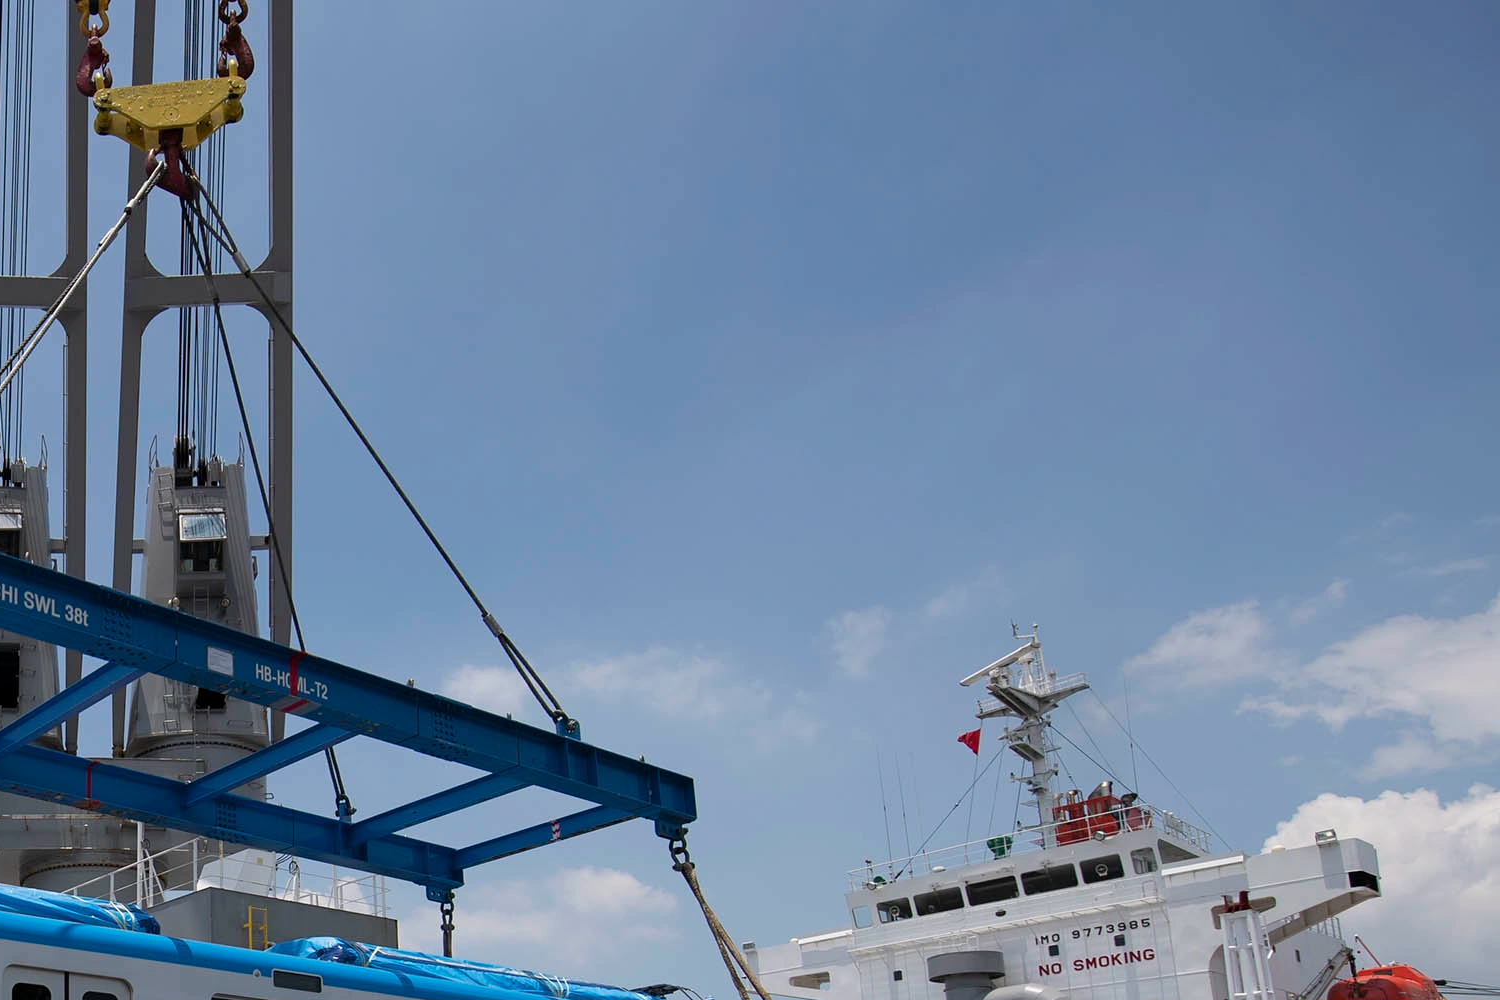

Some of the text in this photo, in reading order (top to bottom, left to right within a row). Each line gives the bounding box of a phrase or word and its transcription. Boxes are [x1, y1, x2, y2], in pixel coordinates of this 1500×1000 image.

[23, 591, 60, 618] SWL
[65, 604, 89, 627] 38t
[1035, 918, 1150, 945] IMO 9773985
[1038, 948, 1155, 976] NO SMOKING
